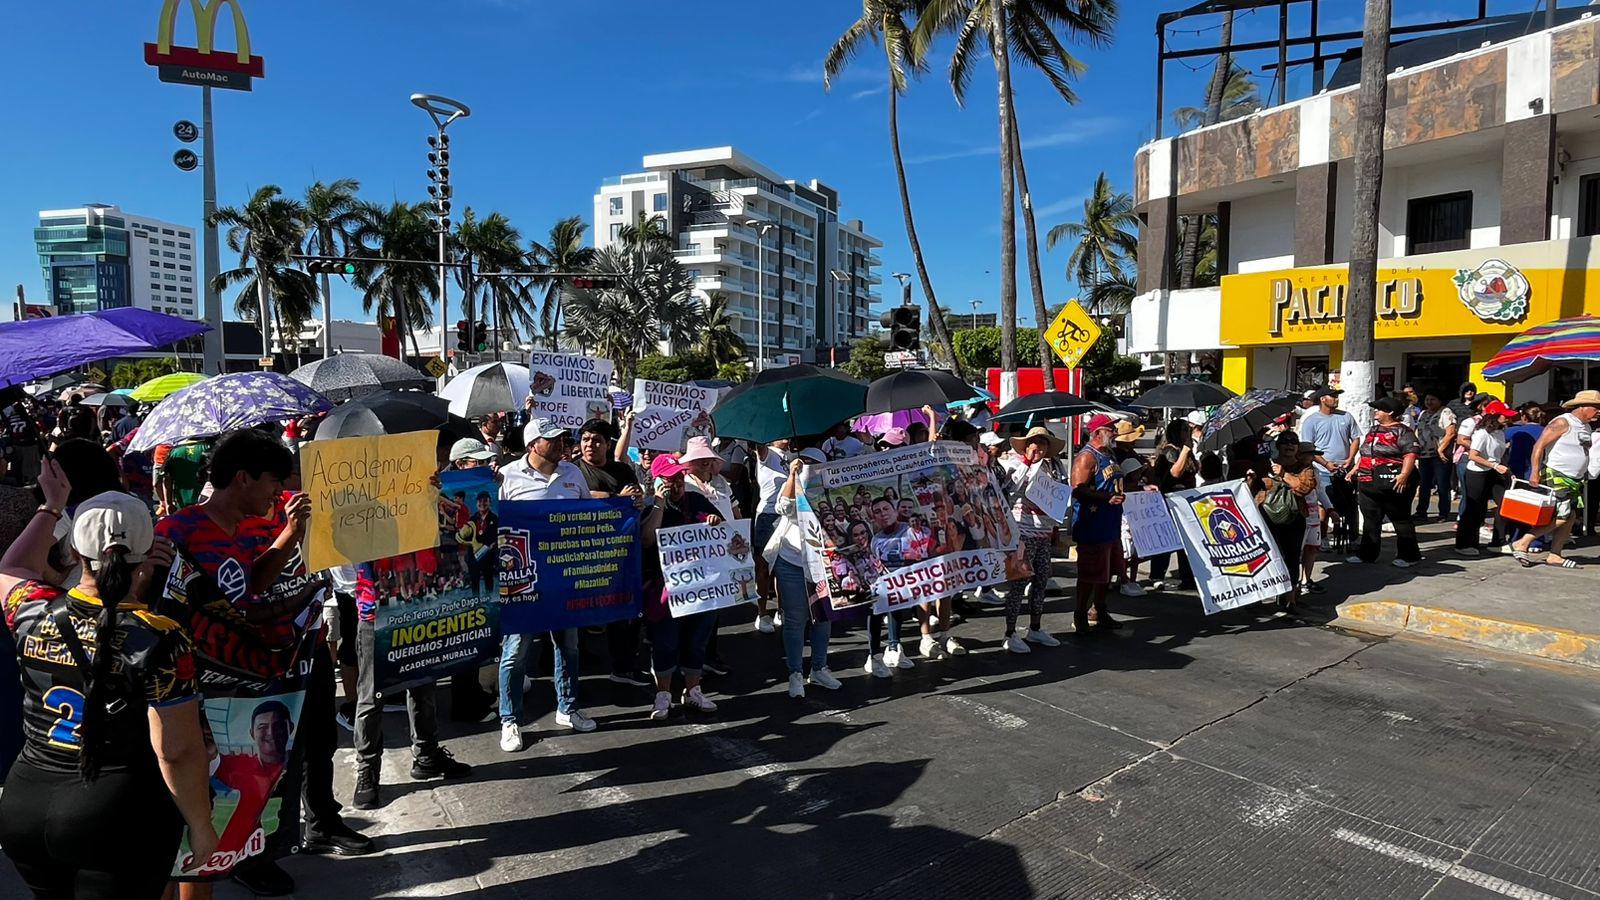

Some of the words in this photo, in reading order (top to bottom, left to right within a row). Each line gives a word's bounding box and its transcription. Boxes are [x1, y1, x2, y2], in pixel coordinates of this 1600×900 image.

[181, 69, 229, 83] AutoMac
[177, 123, 194, 134] 24
[1391, 265, 1427, 276] DEL
[1268, 278, 1424, 338] PACICO
[1288, 323, 1343, 333] MAZATLA
[1376, 318, 1420, 328] NALOA
[532, 353, 595, 371] EXIGIMOS
[558, 368, 608, 386] JUSTICIA
[561, 384, 609, 399] LIBERTAD
[644, 381, 706, 400] EXIGIMOS
[534, 401, 568, 413] PROFE
[645, 393, 702, 411] JUSTICIA
[550, 414, 584, 427] DAGO
[633, 412, 663, 434] SON
[635, 409, 693, 449] INOCENTES
[309, 447, 413, 492] Academia
[826, 467, 840, 475] Tus
[892, 452, 918, 464] padres
[829, 477, 840, 485] de
[841, 475, 849, 483] la
[850, 466, 894, 481] comunidad
[320, 478, 396, 512] MURALLA
[402, 474, 423, 495] los
[339, 497, 408, 532] respalda
[549, 513, 566, 523] Exijo
[567, 512, 592, 521] verdad
[598, 510, 622, 521] justicia
[561, 526, 577, 537] para
[578, 524, 596, 535] Temo
[659, 526, 727, 547] EXIGIMOS
[538, 541, 550, 551] Sin
[550, 539, 580, 551] pruebas
[581, 538, 591, 547] no
[591, 537, 606, 547] hay
[1208, 535, 1264, 559] MURALLA
[662, 544, 726, 566] LIBERTAD
[499, 567, 532, 581] RALLA
[670, 566, 705, 586] SON
[884, 561, 952, 591] JUSTICIA
[670, 582, 740, 607] INOCENTES
[887, 591, 908, 607] EL
[389, 614, 411, 625] Profe
[413, 609, 434, 620] Temo
[441, 602, 461, 613] Profe
[461, 597, 479, 608] Dago
[392, 608, 487, 647] INOCENTES
[387, 641, 443, 662] QUEREMOS
[444, 627, 492, 648] JUSTICIA!!
[399, 656, 441, 674] ACADEMIA
[442, 647, 479, 662] MURALLA
